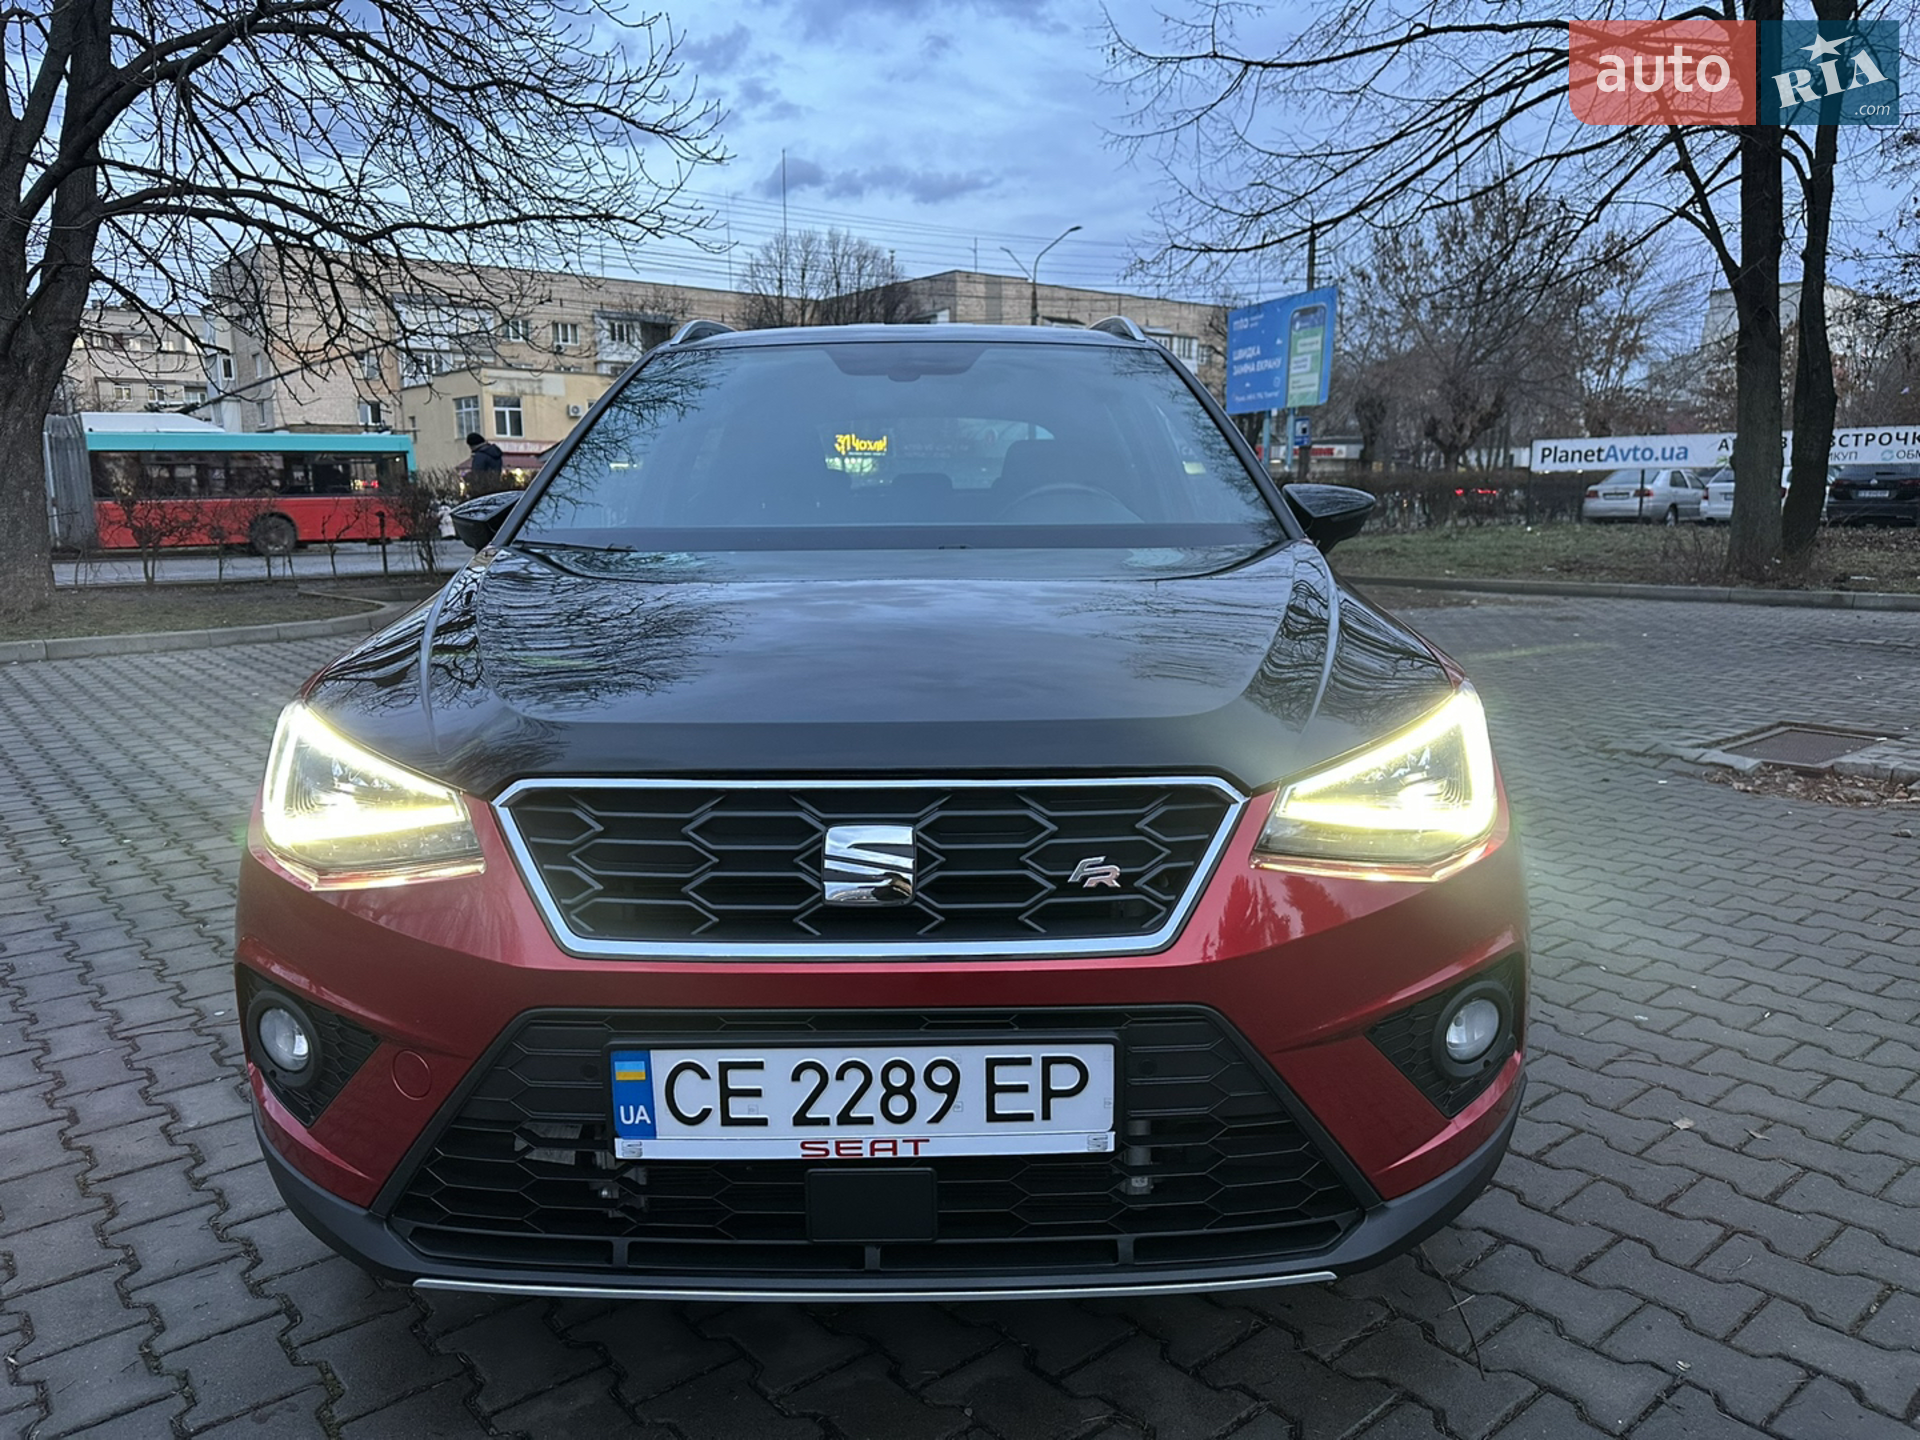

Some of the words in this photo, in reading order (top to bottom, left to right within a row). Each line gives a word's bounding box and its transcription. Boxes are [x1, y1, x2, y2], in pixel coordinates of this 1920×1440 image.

[1540, 445, 1689, 464] PlanetAvto.ua
[664, 1060, 769, 1127] CE
[790, 1058, 962, 1127] 2289
[984, 1055, 1090, 1123] EP
[619, 1104, 651, 1125] UA
[799, 1138, 931, 1158] SEAT
